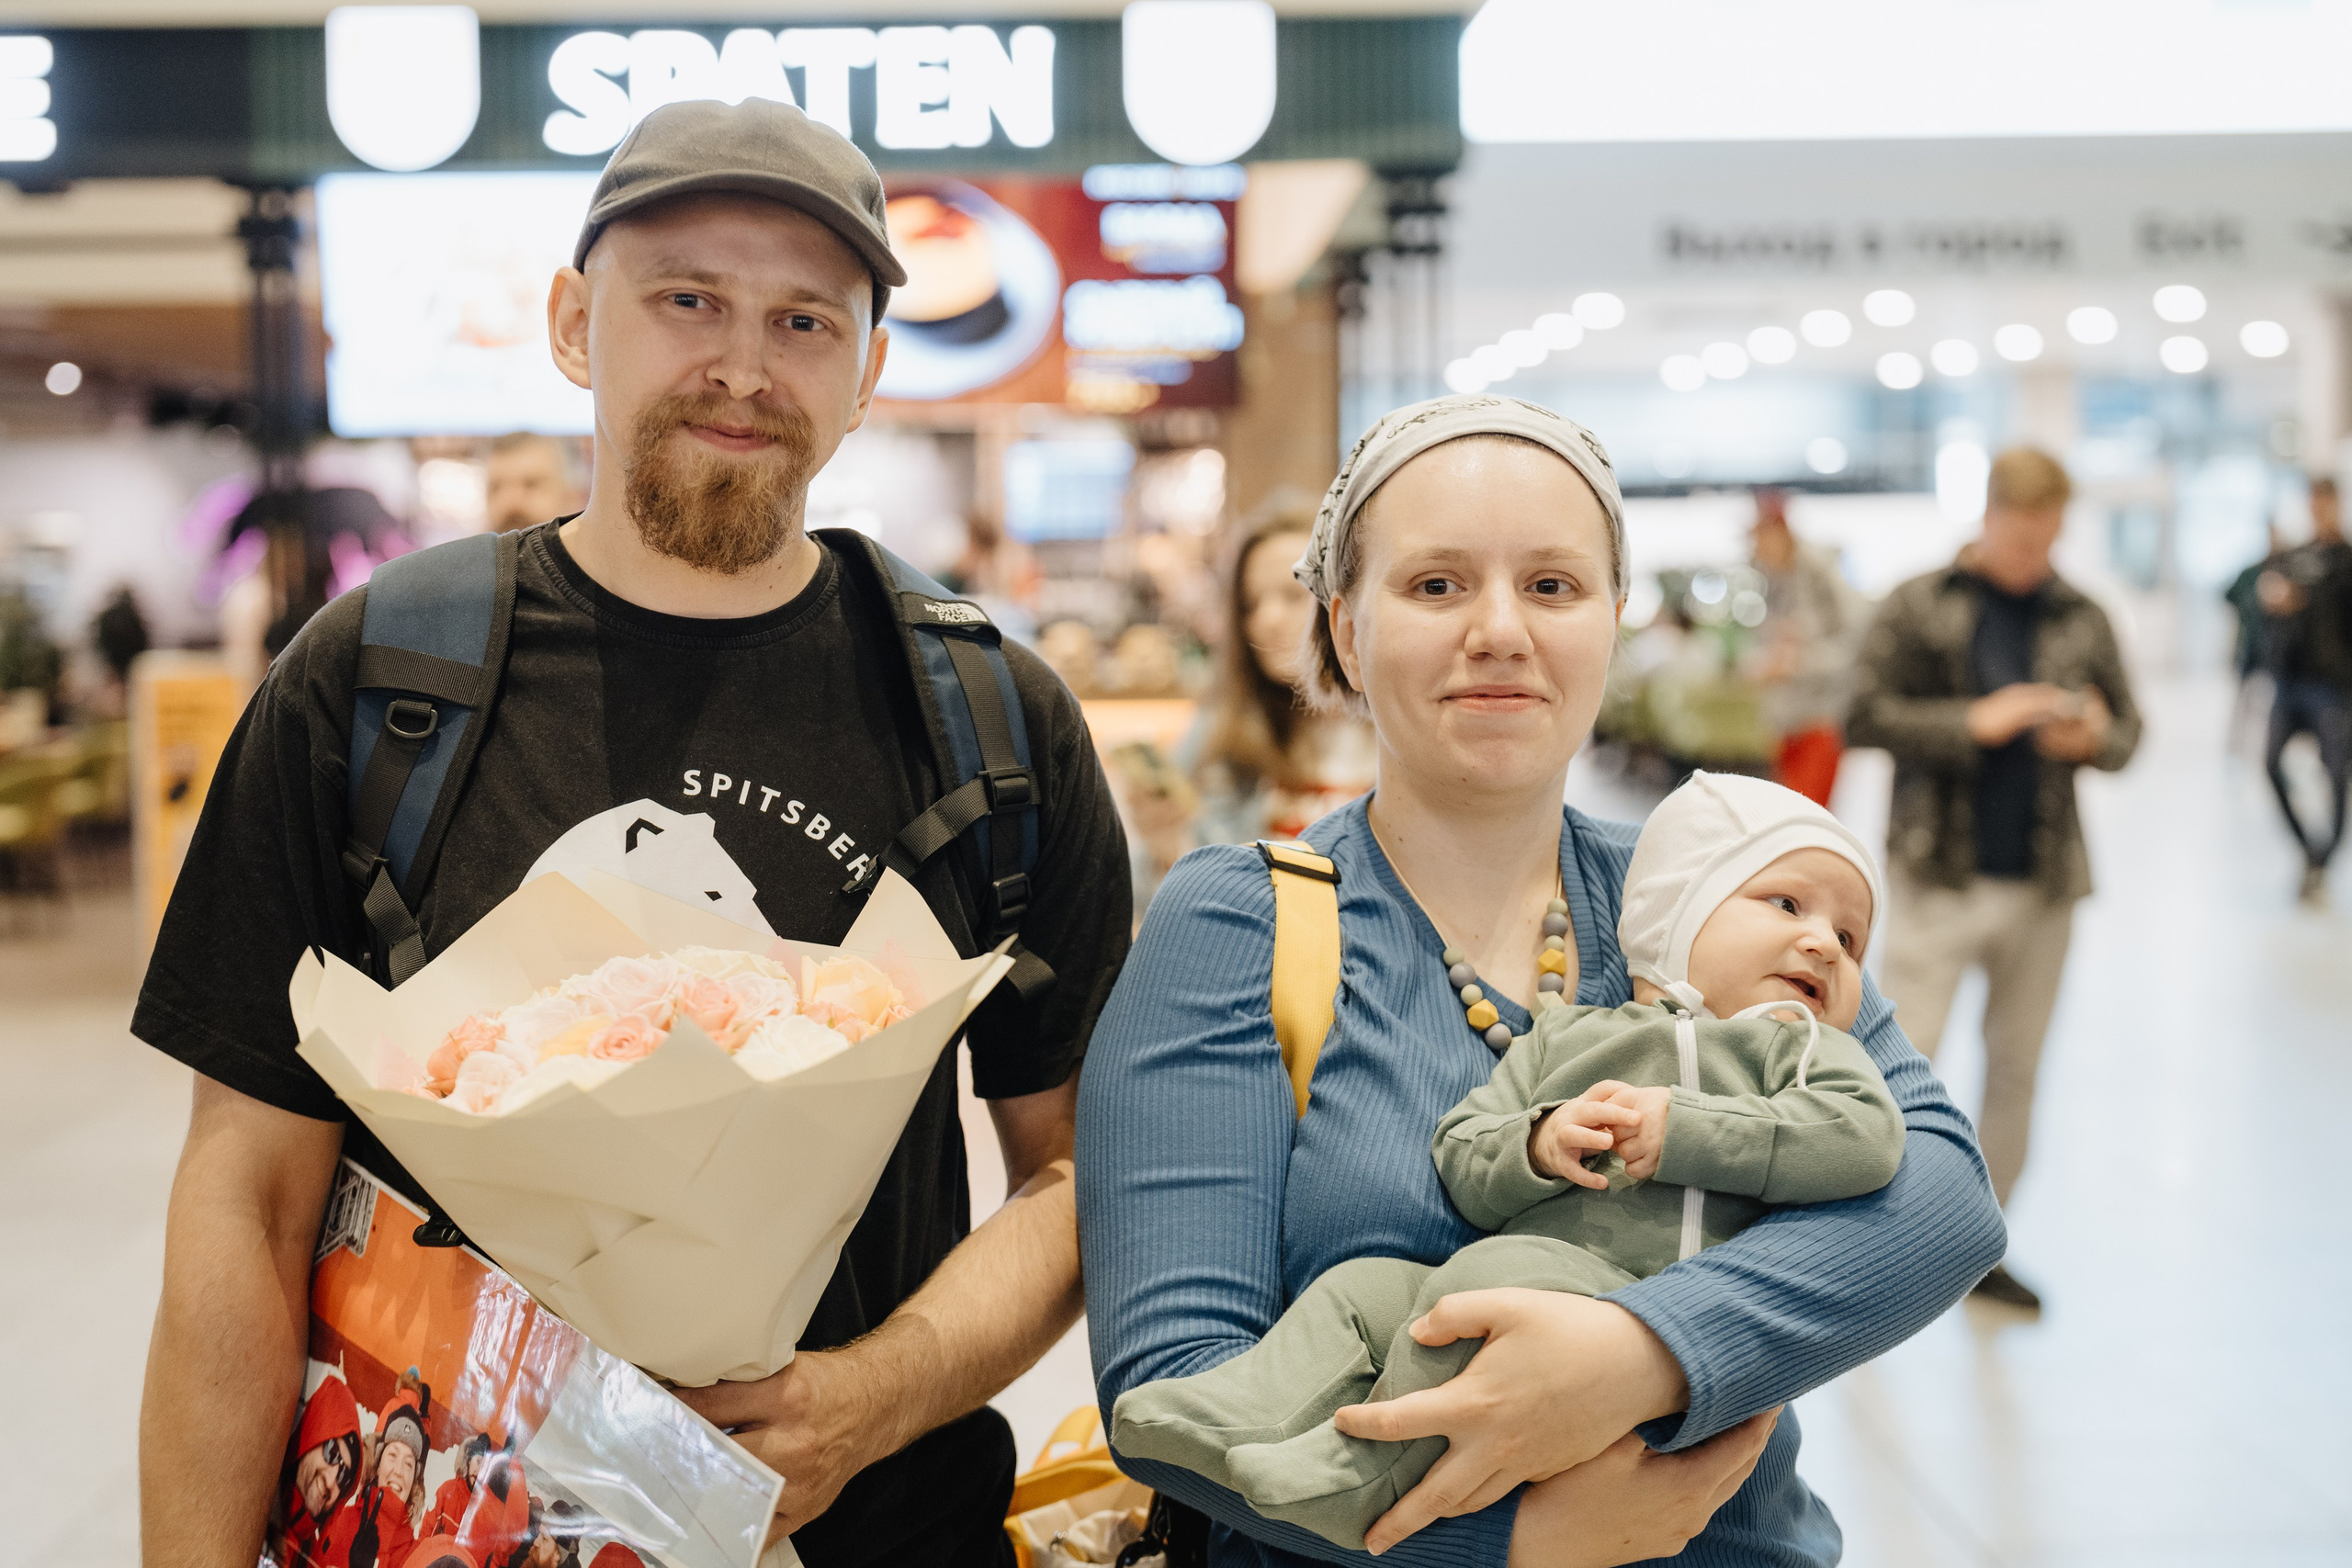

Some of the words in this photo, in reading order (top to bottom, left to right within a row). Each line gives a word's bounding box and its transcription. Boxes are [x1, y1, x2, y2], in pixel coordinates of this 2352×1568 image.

[542, 25, 1057, 156] SPATEN
[923, 604, 964, 615] NORTH
[937, 613, 969, 623] FACE
